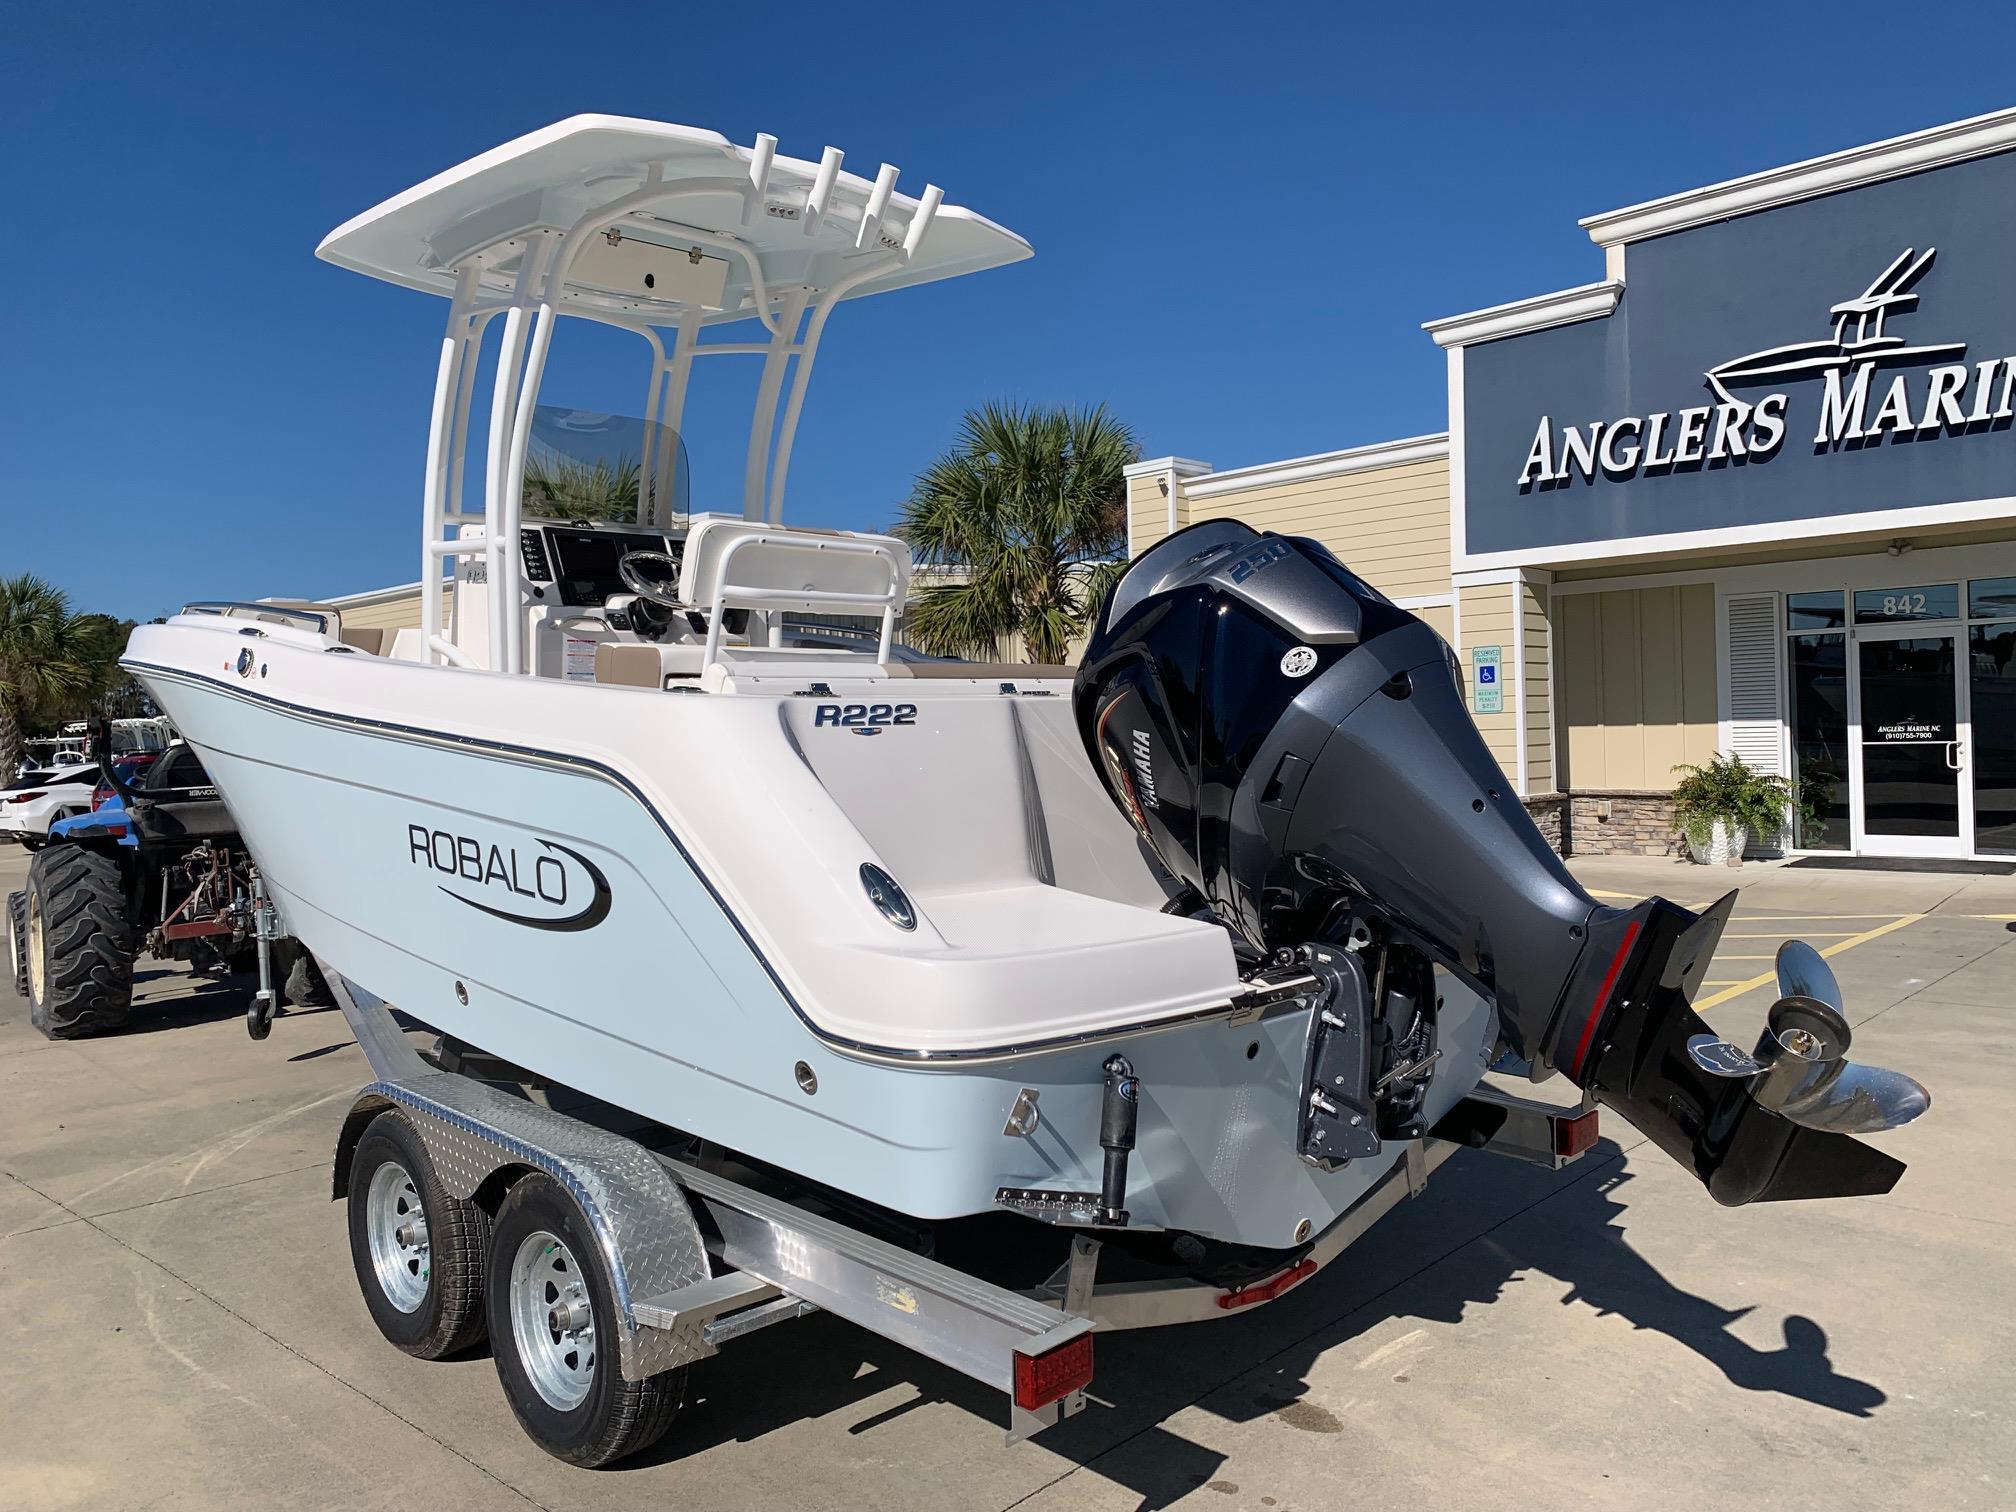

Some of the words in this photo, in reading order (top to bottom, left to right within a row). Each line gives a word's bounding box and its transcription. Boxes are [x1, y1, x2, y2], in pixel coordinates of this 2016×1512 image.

[1517, 393, 1787, 485] ANGLERS
[1883, 594, 1927, 616] 842
[814, 704, 918, 727] R222
[1877, 724, 1906, 733] ANGLERS
[1906, 724, 1930, 732] MARINE
[1931, 724, 1942, 732] NC
[1885, 732, 1933, 740] (910)755-7900
[1132, 729, 1160, 809] YAMAHA
[408, 824, 567, 906] ROBALO
